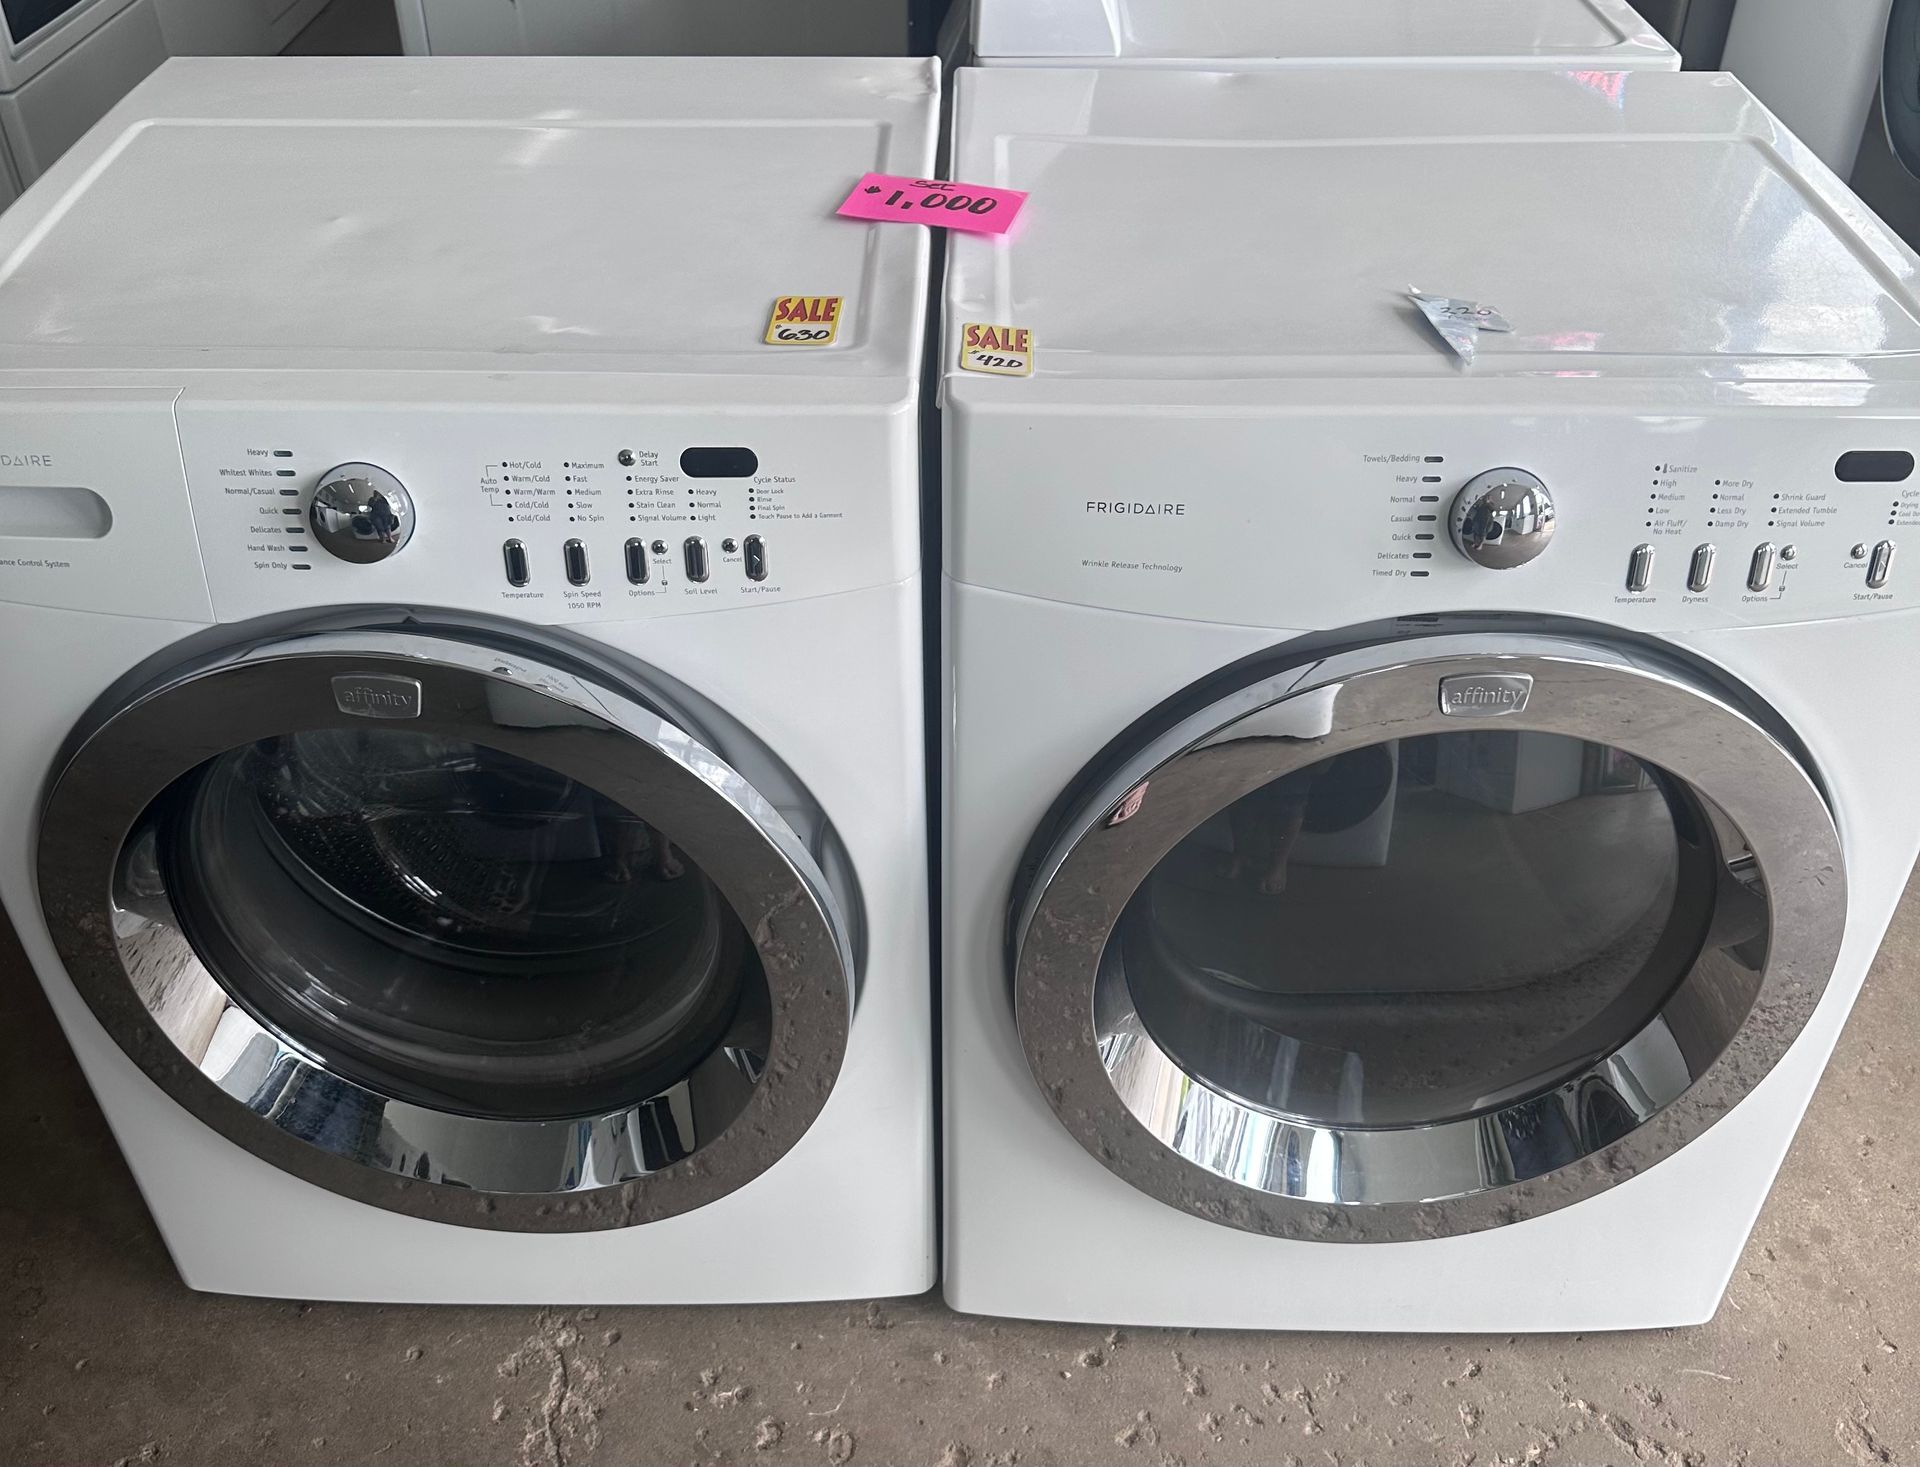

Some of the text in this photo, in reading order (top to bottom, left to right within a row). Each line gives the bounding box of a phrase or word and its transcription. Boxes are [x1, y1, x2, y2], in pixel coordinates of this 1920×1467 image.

[775, 298, 838, 322] SALE
[966, 325, 1028, 352] SALE
[247, 448, 268, 457] Heavy
[639, 450, 659, 459] Delay
[641, 459, 659, 467] Start
[1363, 454, 1421, 463] Towels/Bedding
[509, 461, 542, 469] Hot/Cold
[571, 461, 605, 469] Maximum
[1668, 464, 1698, 473] Sanitize
[219, 469, 272, 477] Whitest Whites
[512, 475, 551, 483] Warm/Cold
[573, 475, 588, 483] Fast
[634, 475, 658, 483] Energy
[753, 475, 796, 485] Cycle Status
[1395, 475, 1418, 484] Heavy
[1660, 479, 1677, 488] High
[1722, 479, 1754, 489] More Dry
[225, 487, 275, 496] Normal/Casual
[480, 486, 500, 494] Temp
[514, 488, 556, 496] Warm/Warm
[574, 488, 602, 496] Medium
[635, 488, 675, 496] Extra Rinse
[695, 488, 717, 497] Heavy
[1390, 495, 1416, 503] Normal
[1657, 493, 1686, 501] Medium
[1719, 493, 1745, 501] Normal
[1780, 493, 1826, 502] Shrink Guard
[514, 501, 550, 509] Cold/Cold
[576, 501, 593, 509] Slow
[636, 501, 676, 509] Stain Clean
[697, 501, 722, 509] Normal
[1086, 501, 1186, 515] FRIGIDAIRE
[259, 506, 278, 515] Quick
[1655, 506, 1670, 514] Low
[1716, 506, 1747, 516] Less Dry
[1777, 506, 1838, 515] Extended Tumble
[516, 514, 551, 522] Cold/Cold
[577, 514, 605, 523] No Spin
[638, 514, 687, 523] Signal Volume
[698, 514, 717, 522] Light
[1653, 519, 1688, 528] Air Fluff/
[1714, 519, 1749, 529] Damp Dry
[1776, 519, 1825, 529] Signal Volume
[250, 525, 282, 534] Delicates
[1653, 528, 1682, 536] No Heat
[1391, 533, 1412, 541] Quick
[247, 544, 285, 552] Hand Wash
[1377, 551, 1409, 560] Delicates
[17, 559, 43, 567] Control
[45, 560, 70, 568] System
[254, 562, 288, 571] Spin Only
[1081, 559, 1183, 573] Wrinkle Release Technology
[1775, 562, 1798, 570] Select
[1843, 562, 1868, 570] Cancel
[1372, 569, 1407, 578] Timed Dry
[628, 589, 656, 598] Options
[684, 587, 718, 595] Soil Level
[740, 585, 781, 594] Start/Pause
[502, 591, 544, 600] Temperature
[563, 590, 602, 599] Spin Speed
[1741, 594, 1768, 604] Options
[1852, 591, 1893, 601] Start/Pause
[1613, 595, 1657, 604] Temperature
[1682, 595, 1709, 605] Dryness
[343, 686, 412, 707] affinity
[1451, 686, 1525, 710] affinity
